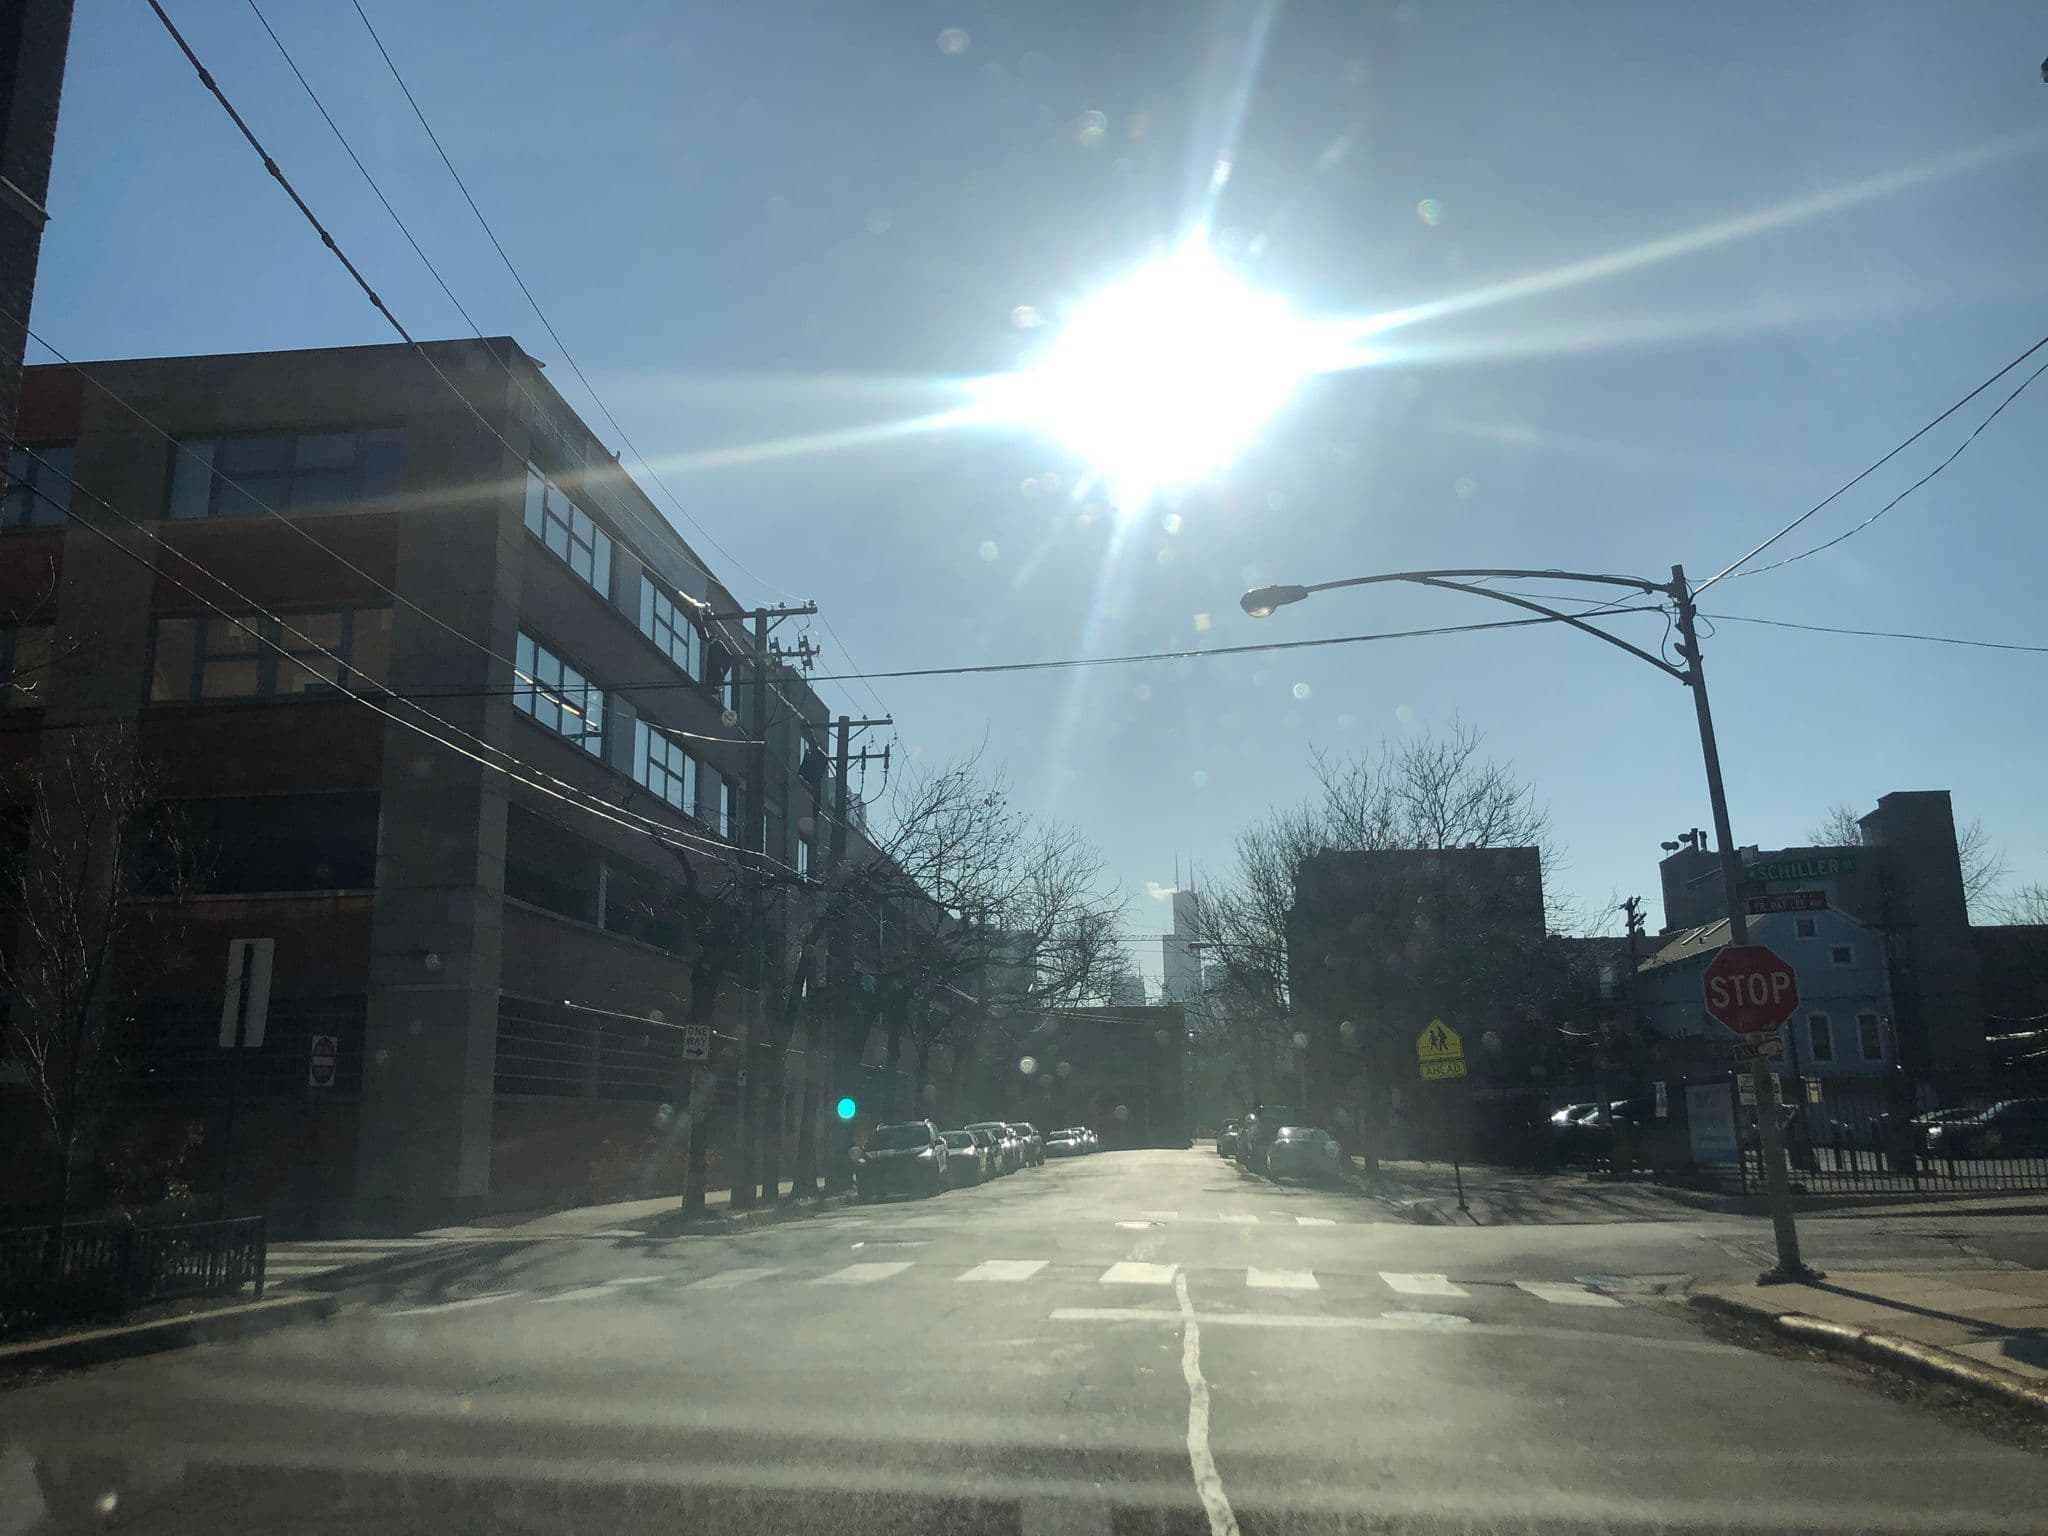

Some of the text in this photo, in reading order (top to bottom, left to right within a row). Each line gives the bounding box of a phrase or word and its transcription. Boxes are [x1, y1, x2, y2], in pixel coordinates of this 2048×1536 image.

[1759, 859, 1840, 880] SCHILLER
[1711, 971, 1791, 1009] STOP
[687, 1026, 708, 1037] ONE
[687, 1036, 706, 1047] WAY
[1425, 1063, 1462, 1076] AHEAD
